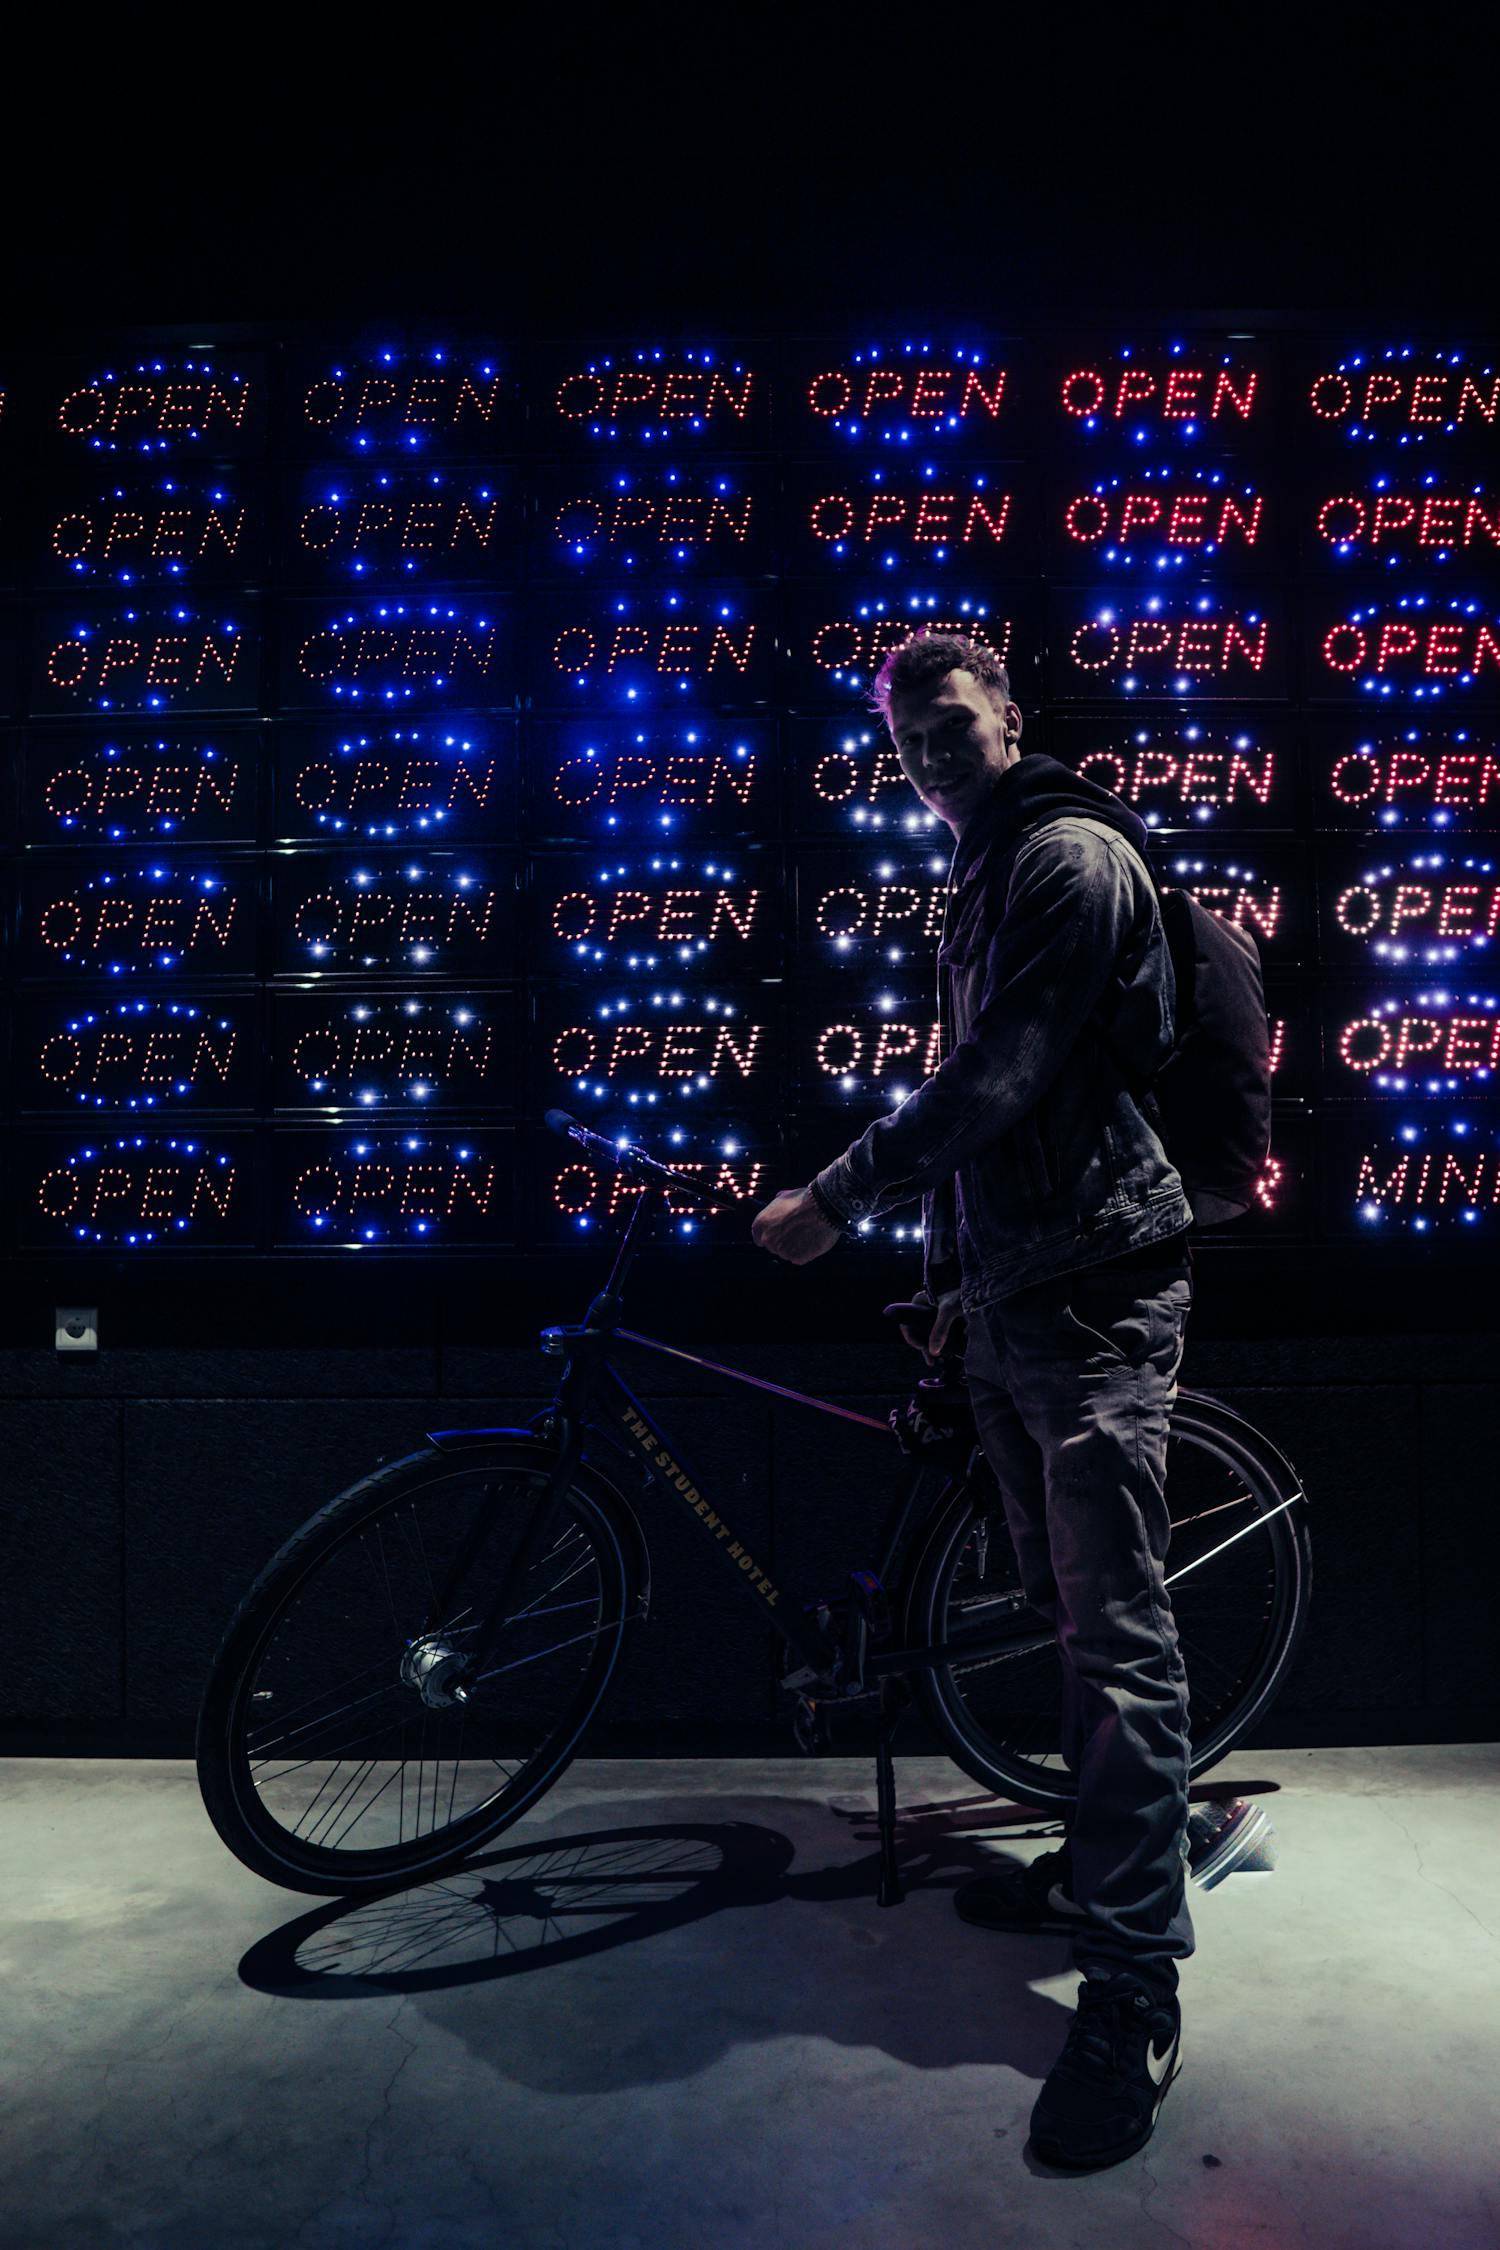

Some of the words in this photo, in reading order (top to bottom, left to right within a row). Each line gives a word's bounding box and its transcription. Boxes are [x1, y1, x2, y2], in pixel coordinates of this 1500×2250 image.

[57, 382, 250, 434] OPEN
[303, 376, 500, 427] OPEN
[554, 371, 755, 421] OPEN
[806, 370, 1008, 419] OPEN
[1060, 369, 1260, 420] OPEN
[1309, 373, 1500, 424] OPEN
[50, 505, 245, 560] OPEN
[299, 500, 498, 551] OPEN
[553, 496, 754, 544] OPEN
[809, 494, 1014, 543] OPEN
[1063, 495, 1265, 546] OPEN
[46, 633, 243, 688] OPEN
[298, 629, 497, 681] OPEN
[552, 624, 757, 674] OPEN
[1069, 621, 1269, 672] OPEN
[44, 762, 241, 817] OPEN
[295, 758, 495, 811] OPEN
[552, 756, 756, 806] OPEN
[39, 897, 238, 953] OPEN
[294, 889, 496, 944] OPEN
[551, 887, 760, 943] OPEN
[38, 1031, 239, 1085] OPEN
[292, 1026, 495, 1081] OPEN
[551, 1025, 761, 1079] OPEN
[36, 1166, 237, 1220] OPEN
[293, 1164, 495, 1216] OPEN
[621, 1406, 659, 1452] THE
[654, 1450, 731, 1540] STUDENT
[726, 1540, 780, 1607] HOTEL
